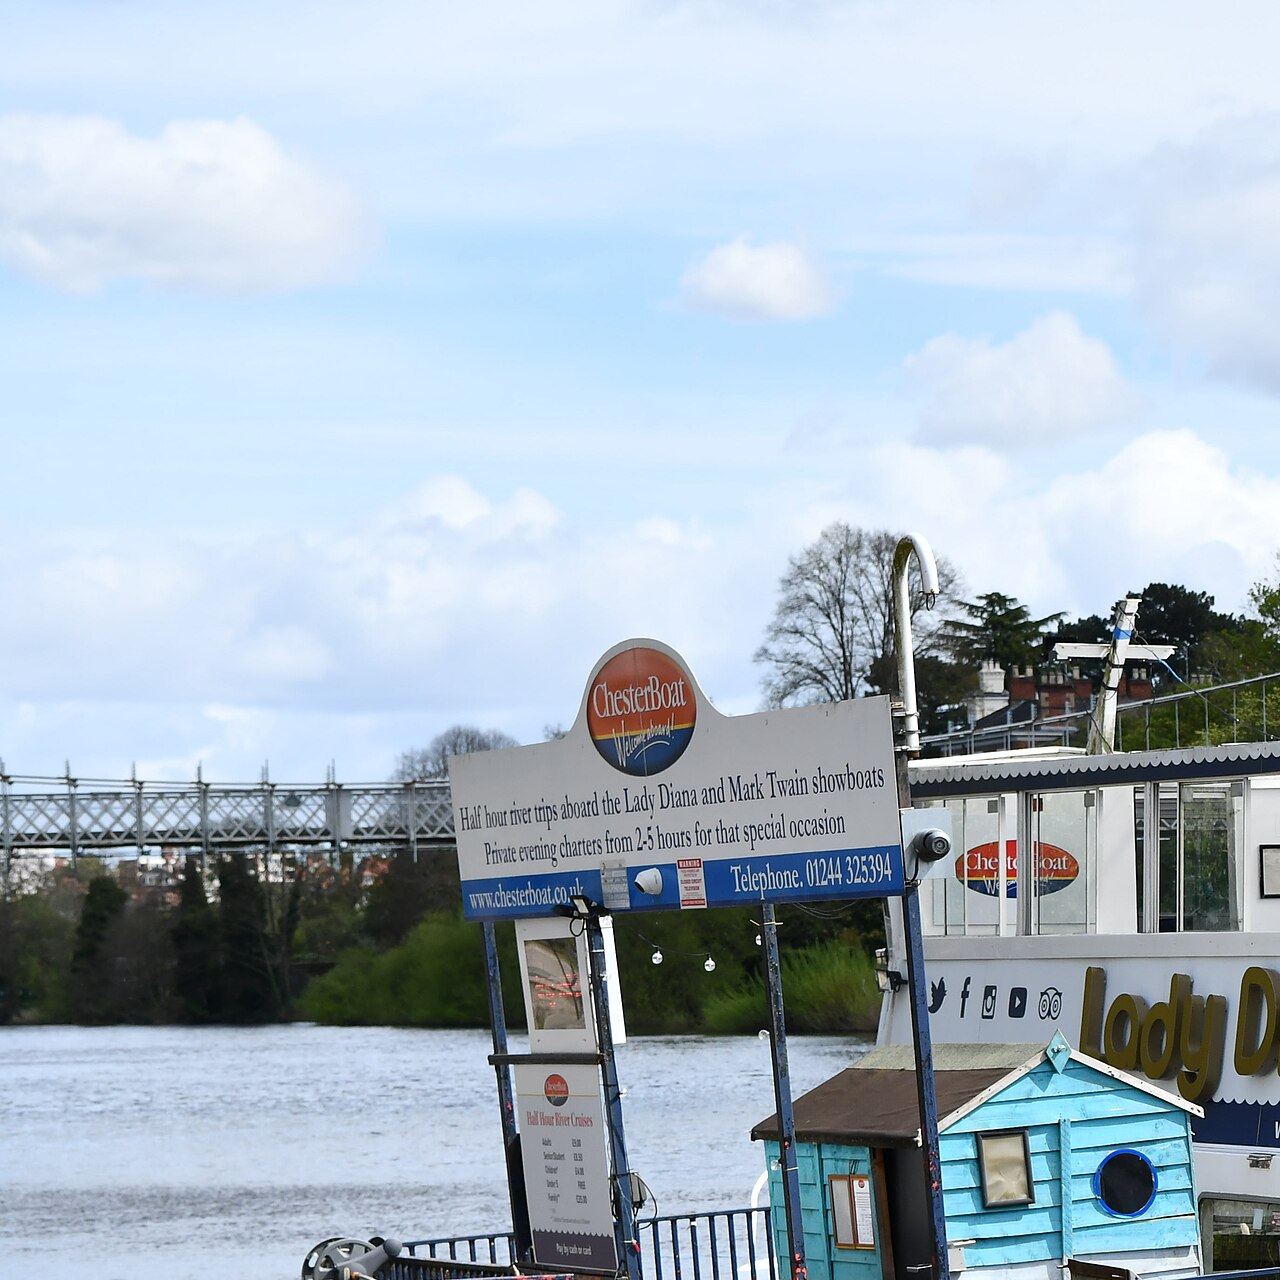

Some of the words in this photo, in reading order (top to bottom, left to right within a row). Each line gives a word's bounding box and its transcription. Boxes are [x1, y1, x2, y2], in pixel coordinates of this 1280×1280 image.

[593, 675, 687, 718] ChesterBoat
[612, 719, 647, 768] Welcome
[646, 712, 675, 740] aboard!
[459, 805, 482, 831] Half
[484, 804, 507, 829] hour
[509, 801, 532, 825] river
[534, 798, 559, 830] trips
[561, 791, 600, 820] aboard
[602, 790, 621, 816] the
[624, 785, 655, 820] Lady
[658, 782, 698, 810] Diana
[701, 777, 726, 805] and
[728, 773, 765, 803] Mark
[766, 769, 809, 799] Twain
[812, 762, 885, 795] showboats
[484, 841, 517, 866] Private
[518, 836, 559, 868] evening
[559, 833, 603, 857] charters
[605, 829, 633, 854] from
[635, 825, 655, 852] 2-5
[656, 821, 692, 850] hours
[694, 820, 713, 846] for
[715, 819, 740, 845] that
[743, 812, 787, 851] special
[789, 808, 846, 838] occasion
[469, 877, 584, 911] www.chesterboat.co.uk
[730, 861, 804, 900] Telephone.
[805, 856, 843, 888] 01244
[845, 851, 892, 885] 325394
[1079, 966, 1229, 1102] Lady
[570, 1112, 594, 1128] Cruises
